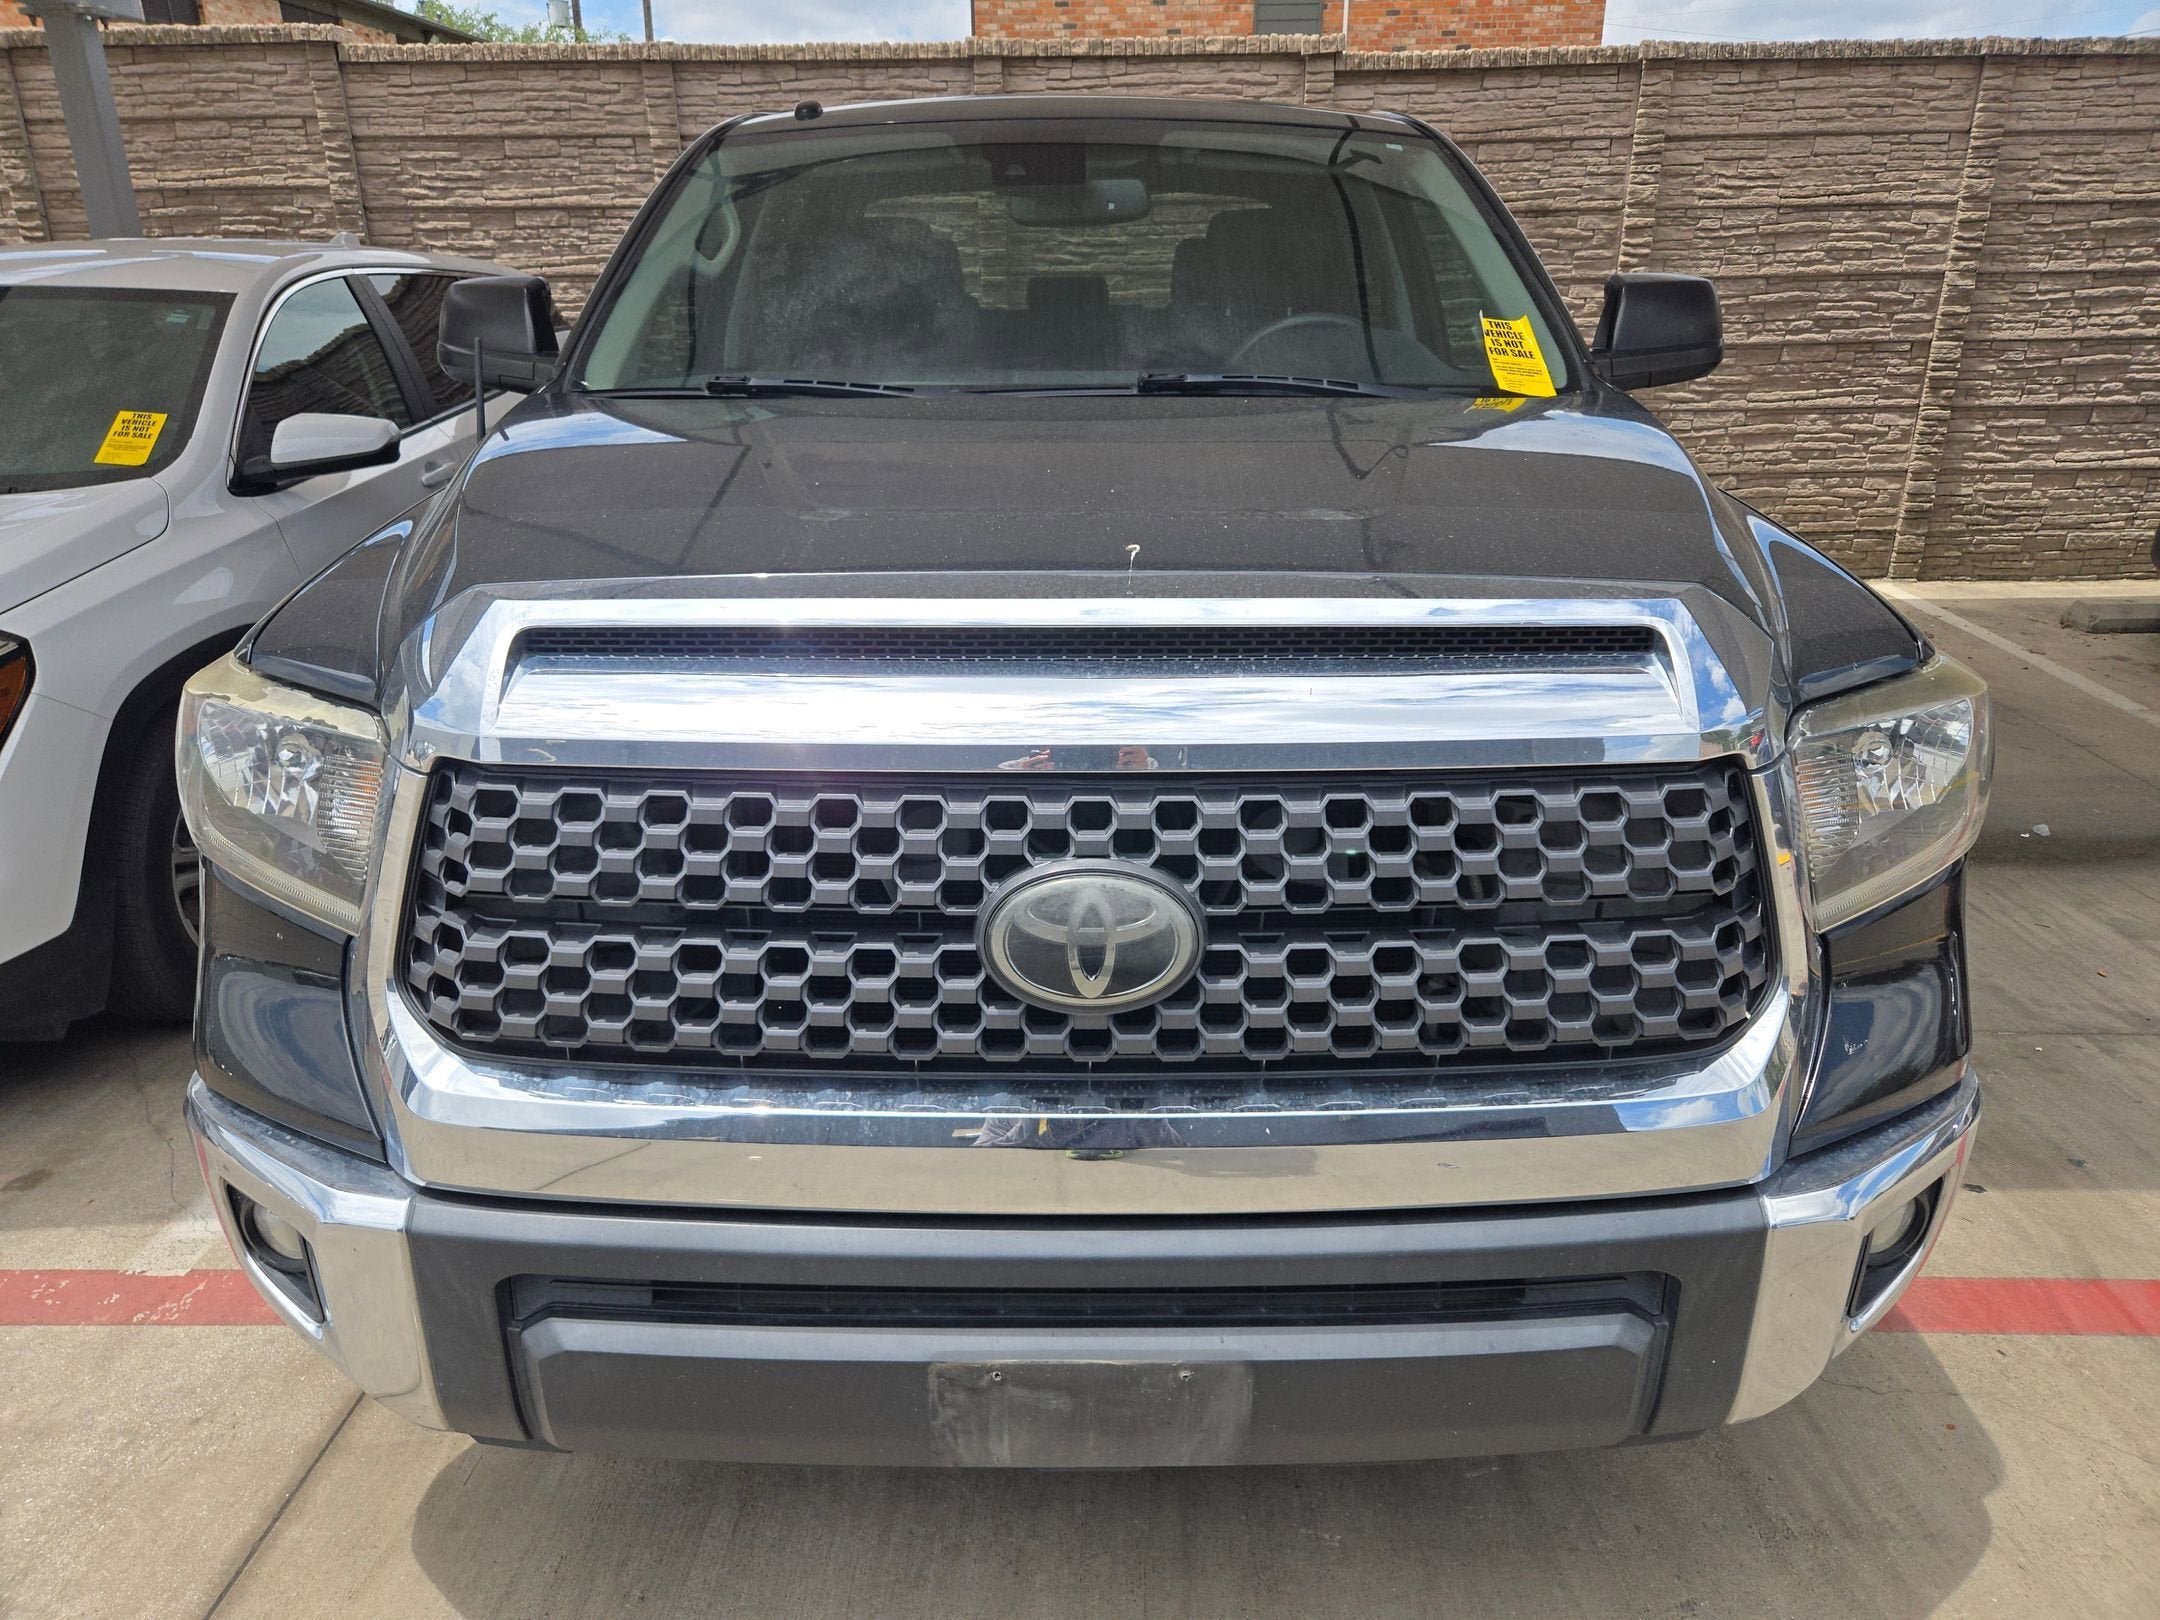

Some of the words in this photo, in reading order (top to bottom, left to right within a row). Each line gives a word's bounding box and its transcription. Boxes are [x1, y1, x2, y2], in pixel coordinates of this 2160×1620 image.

[1487, 320, 1512, 331] THIS
[1484, 329, 1524, 341] VEHICLE
[1491, 338, 1502, 347] IS
[1505, 340, 1524, 349] NOT
[1489, 347, 1509, 357] FOR
[1511, 349, 1535, 359] SALE
[121, 419, 156, 427] VEHICLE
